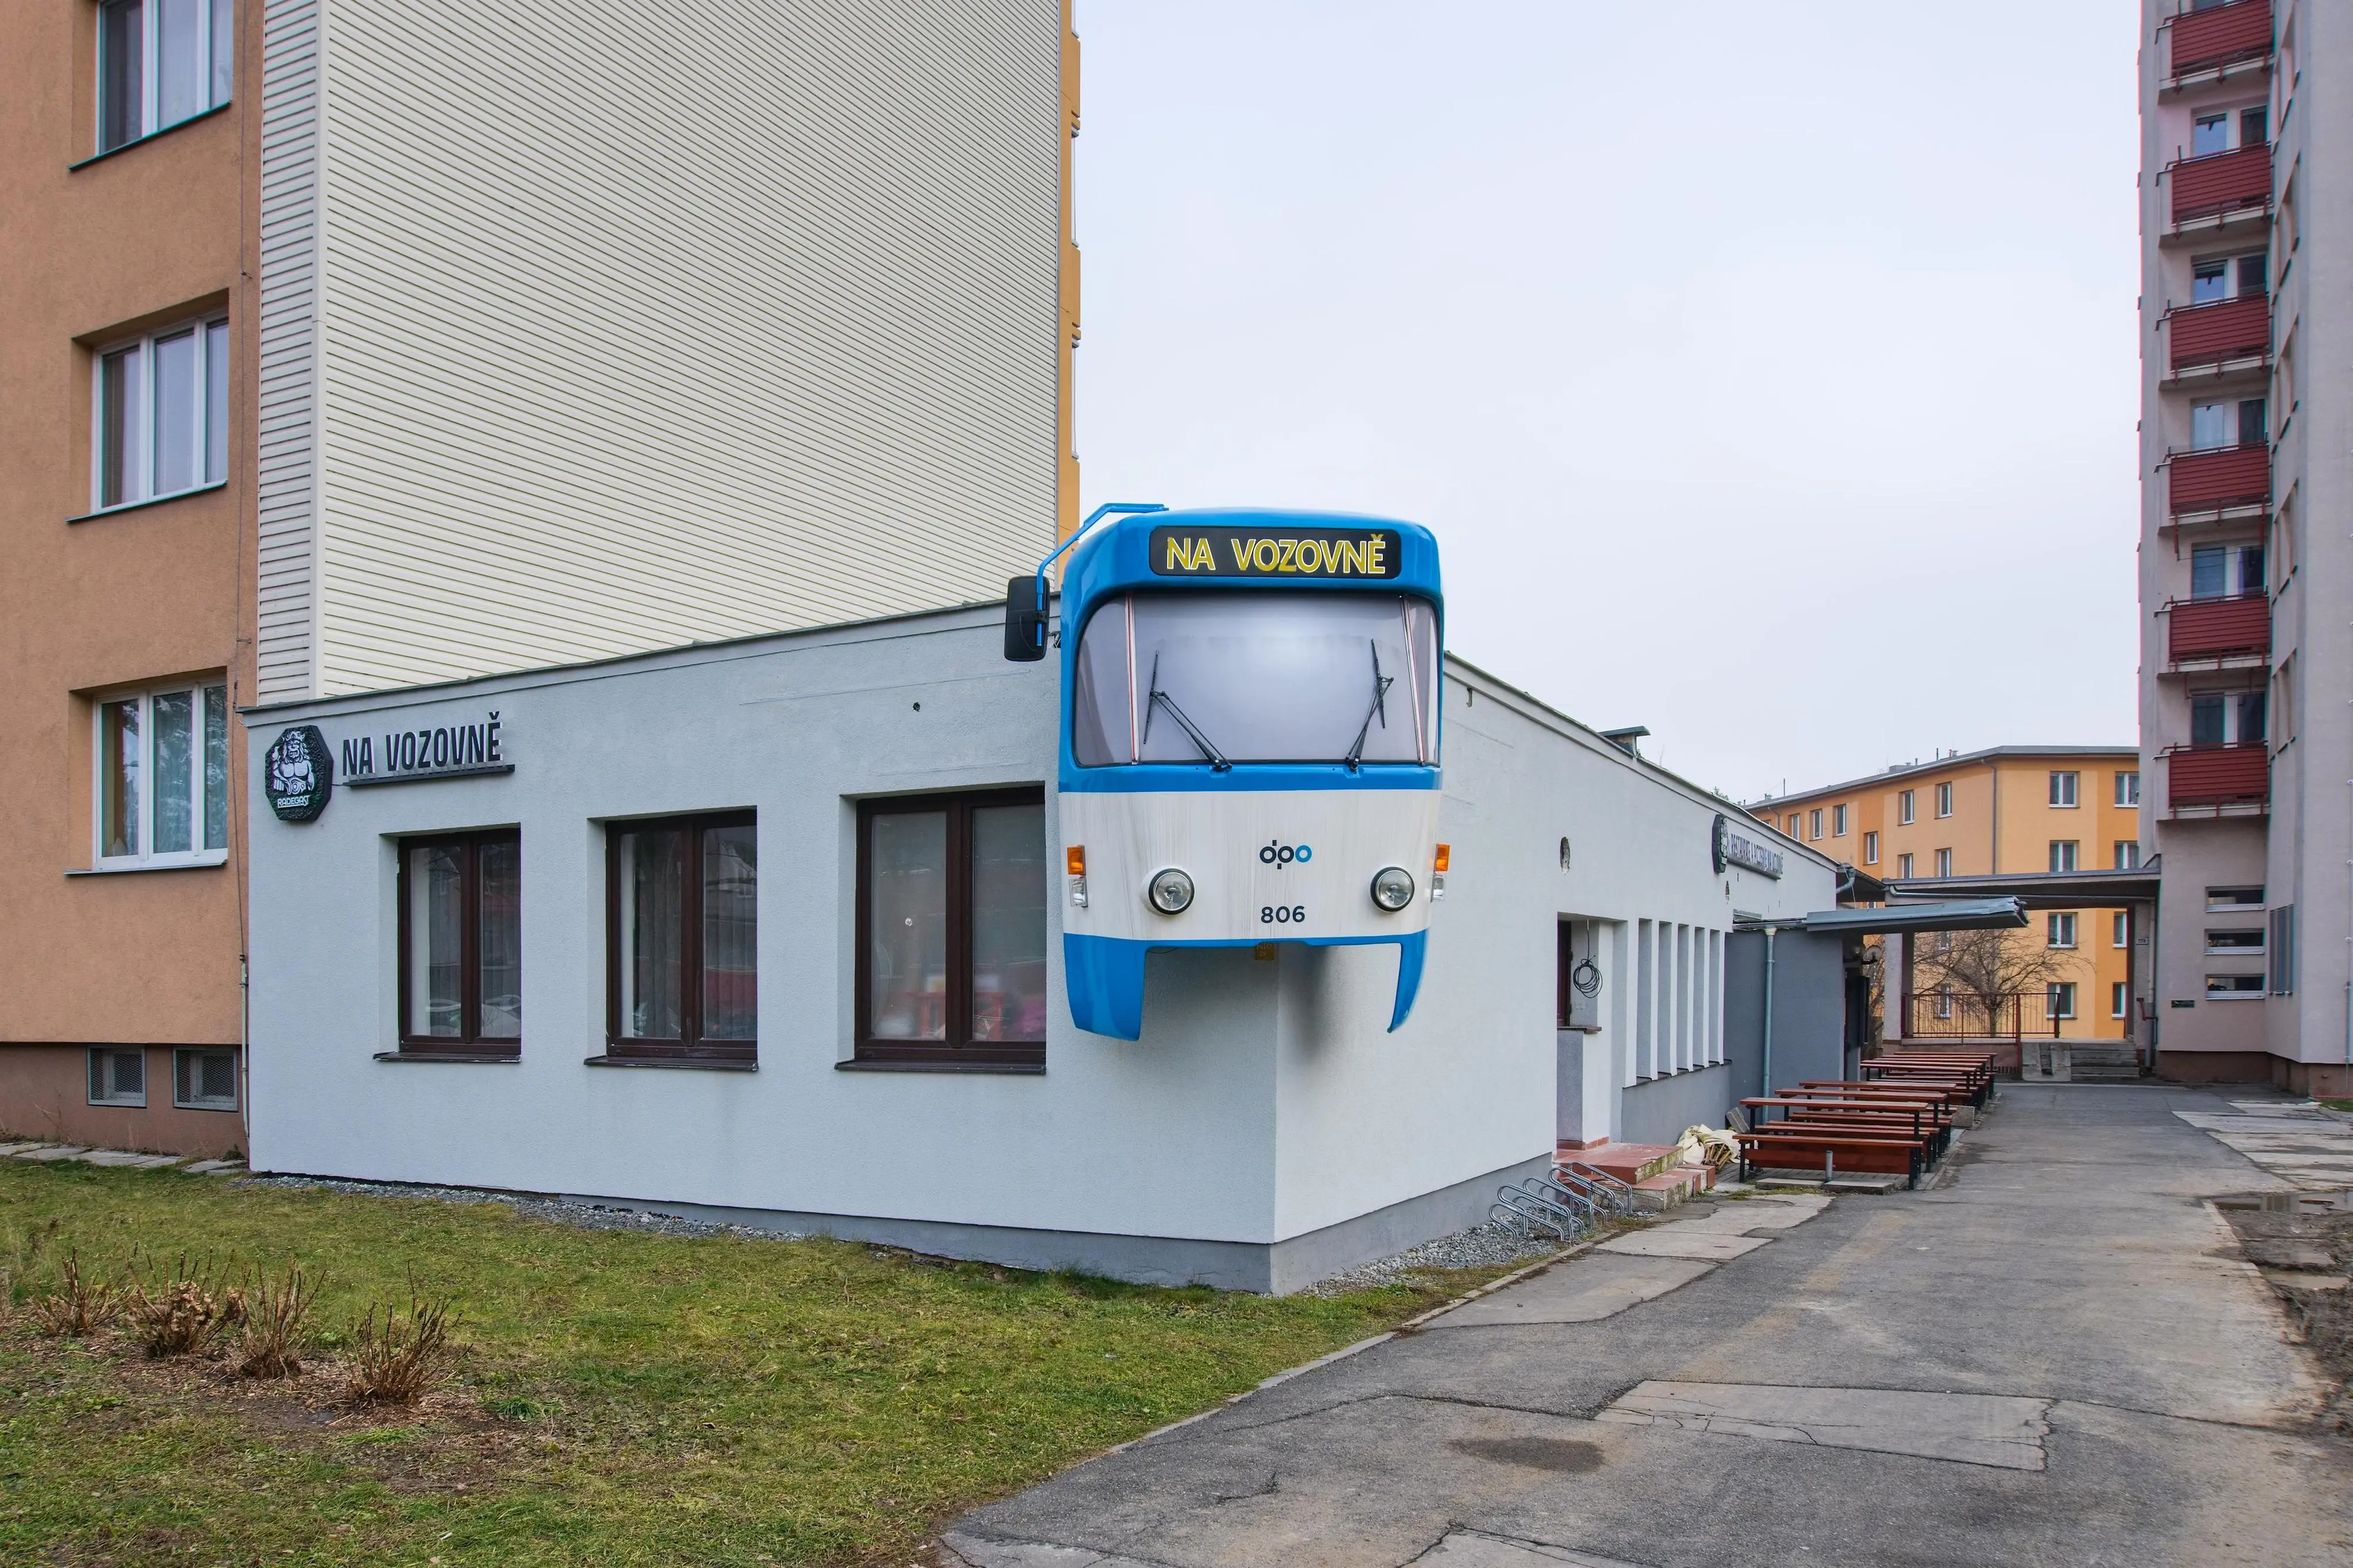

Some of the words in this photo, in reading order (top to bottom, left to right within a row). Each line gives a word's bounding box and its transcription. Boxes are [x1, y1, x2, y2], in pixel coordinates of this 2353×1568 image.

[1166, 538, 1216, 571] NA
[1231, 534, 1386, 574] VOZOVNĚ
[342, 737, 375, 776] NA
[386, 711, 503, 772] VOZOVNĚ
[278, 795, 310, 808] RADEGAST
[1259, 840, 1312, 869] dpo
[1261, 906, 1305, 923] 806
